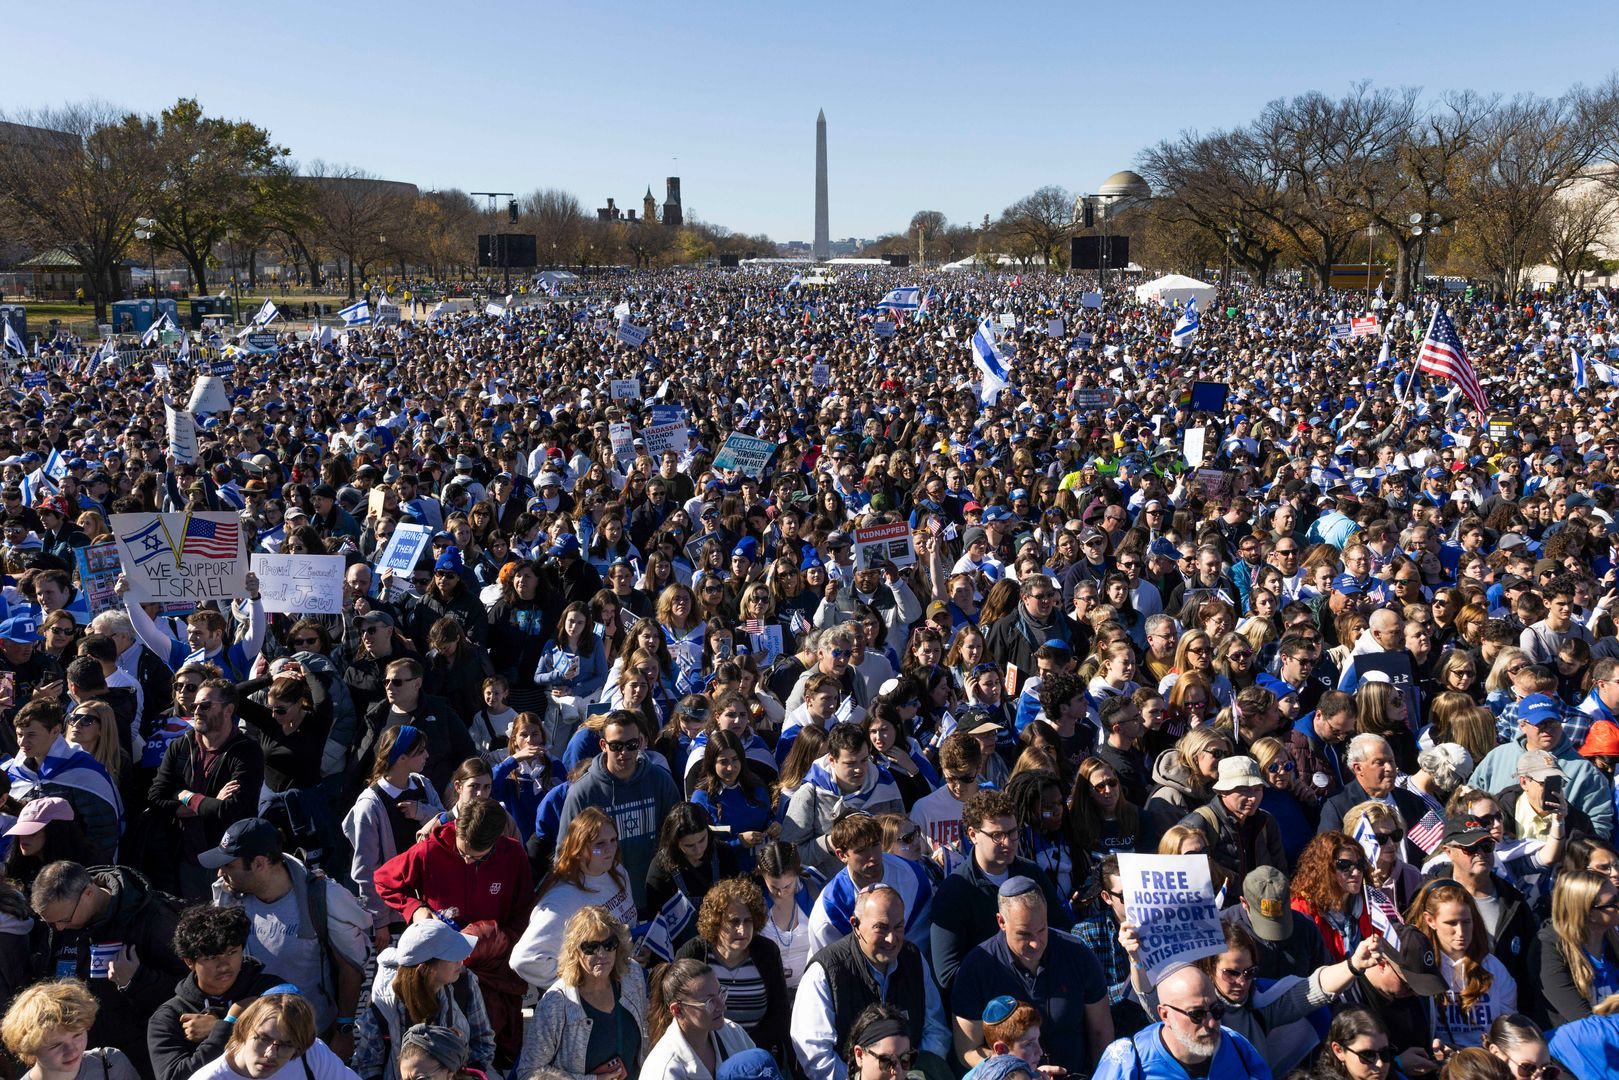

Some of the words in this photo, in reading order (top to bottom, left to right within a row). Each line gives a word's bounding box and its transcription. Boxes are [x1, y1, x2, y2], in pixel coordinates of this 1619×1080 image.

[621, 327, 642, 339] ISRAEL
[212, 364, 235, 374] HOME
[645, 423, 684, 435] HADASSAH
[646, 431, 674, 441] STANDS
[648, 438, 667, 447] WITH
[649, 443, 674, 453] ISRAEL
[730, 438, 769, 451] CLEVELAND
[735, 449, 767, 460] STRONGER
[733, 457, 749, 467] THAN
[748, 459, 765, 469] HATE
[400, 529, 423, 541] BRING
[859, 525, 906, 539] KIDNAPPED
[395, 544, 415, 555] THEM
[144, 561, 172, 578] WE
[179, 560, 237, 578] SUPPORT
[259, 558, 292, 577] Proud
[388, 557, 410, 569] HOME
[150, 577, 232, 597] ISRAEL
[290, 584, 334, 611] Jew
[147, 740, 163, 749] DC
[1140, 870, 1189, 890] FREE
[1134, 891, 1203, 905] HOSTAGES
[1126, 904, 1217, 927] SUPPORT
[1150, 922, 1198, 934] ISRAEL
[1140, 929, 1216, 953] COMBAT
[1144, 938, 1227, 971] ANTISEMITISM
